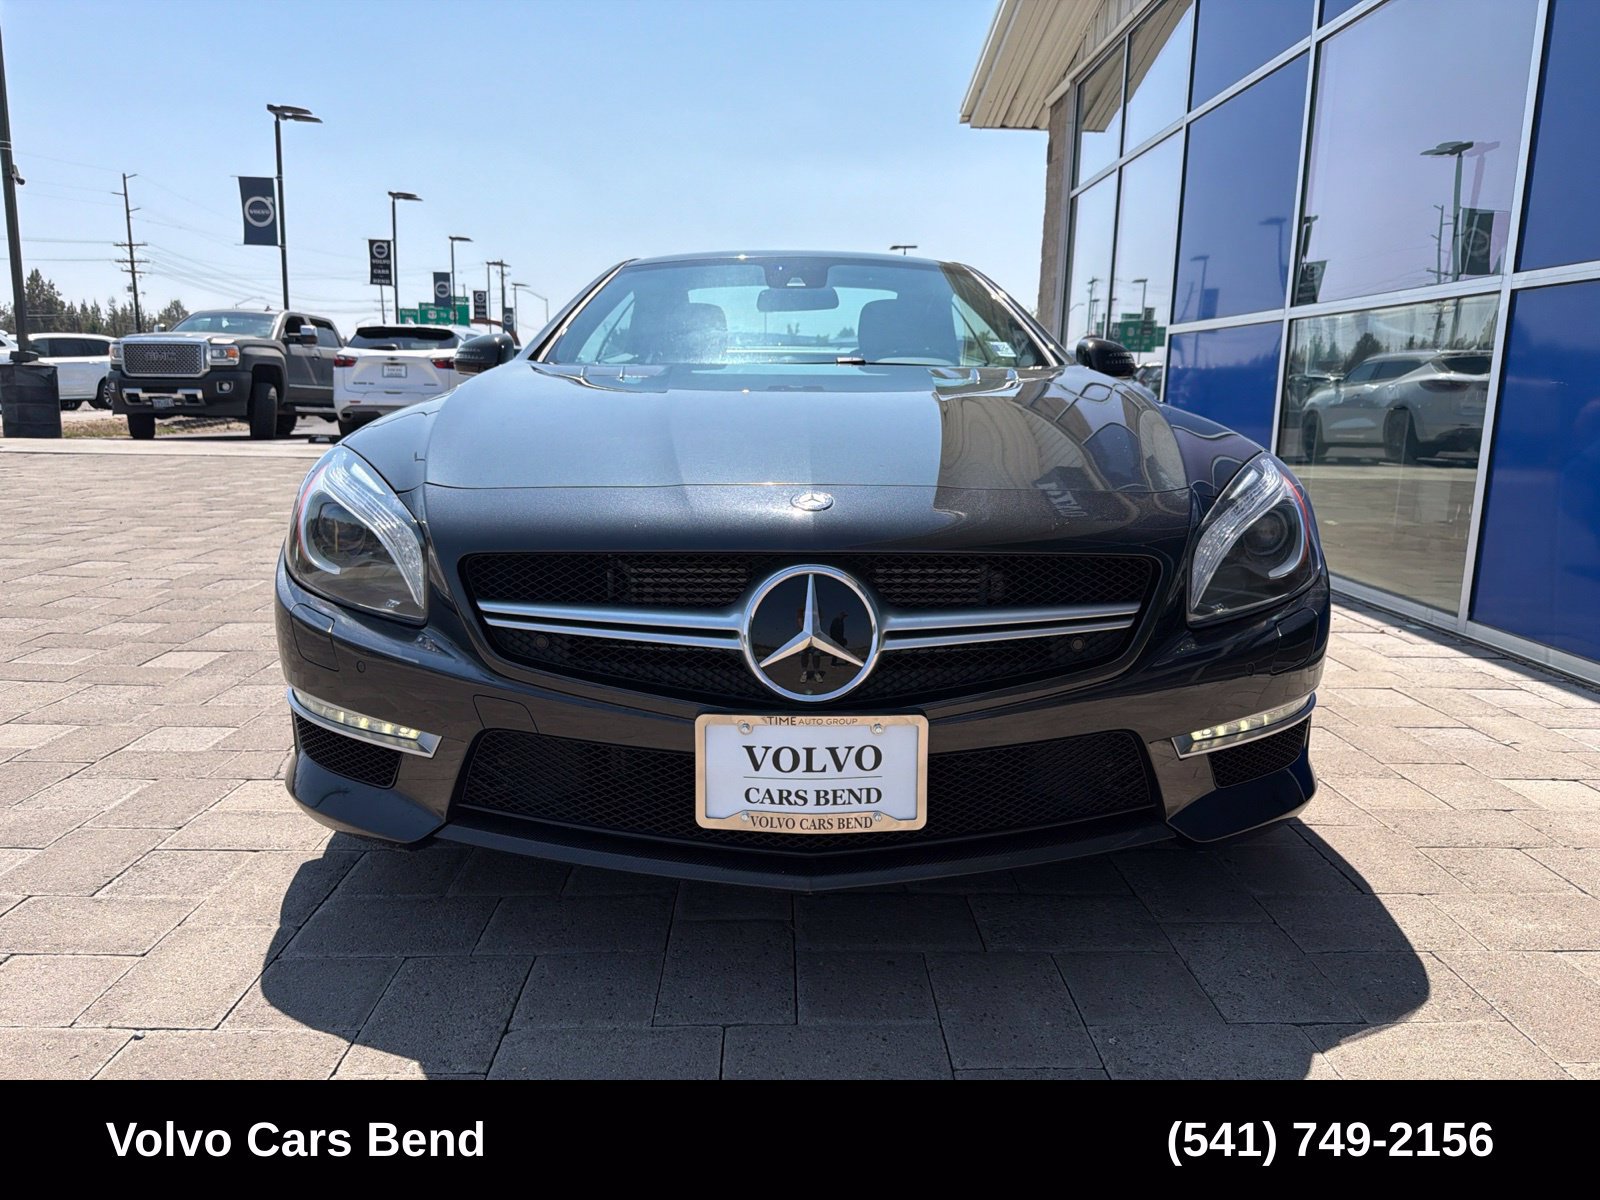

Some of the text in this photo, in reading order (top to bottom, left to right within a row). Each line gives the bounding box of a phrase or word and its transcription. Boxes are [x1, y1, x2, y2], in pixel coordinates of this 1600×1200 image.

[767, 716, 797, 726] TIME
[742, 744, 883, 773] VOLVO
[744, 787, 883, 807] CARS BEND
[750, 815, 873, 830] VOLVO CARS BEND
